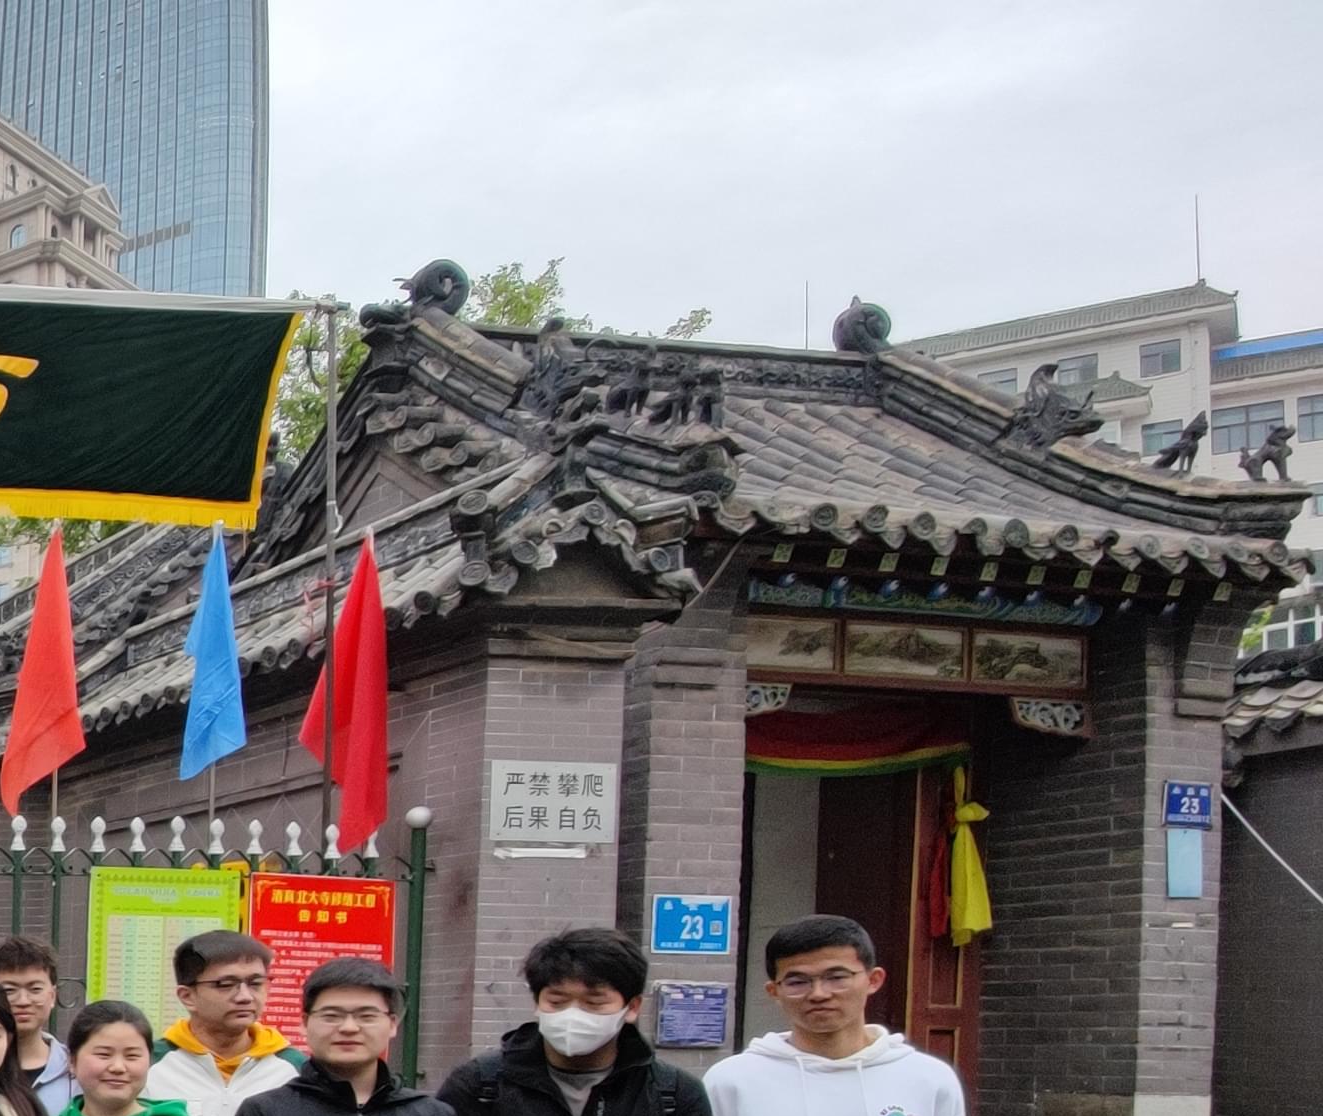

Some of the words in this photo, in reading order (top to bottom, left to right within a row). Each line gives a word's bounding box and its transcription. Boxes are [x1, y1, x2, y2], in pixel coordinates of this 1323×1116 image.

[503, 772, 604, 797] 严禁攀爬
[502, 805, 602, 831] 后果自负
[1180, 797, 1200, 814] 23
[680, 914, 704, 940] 23
